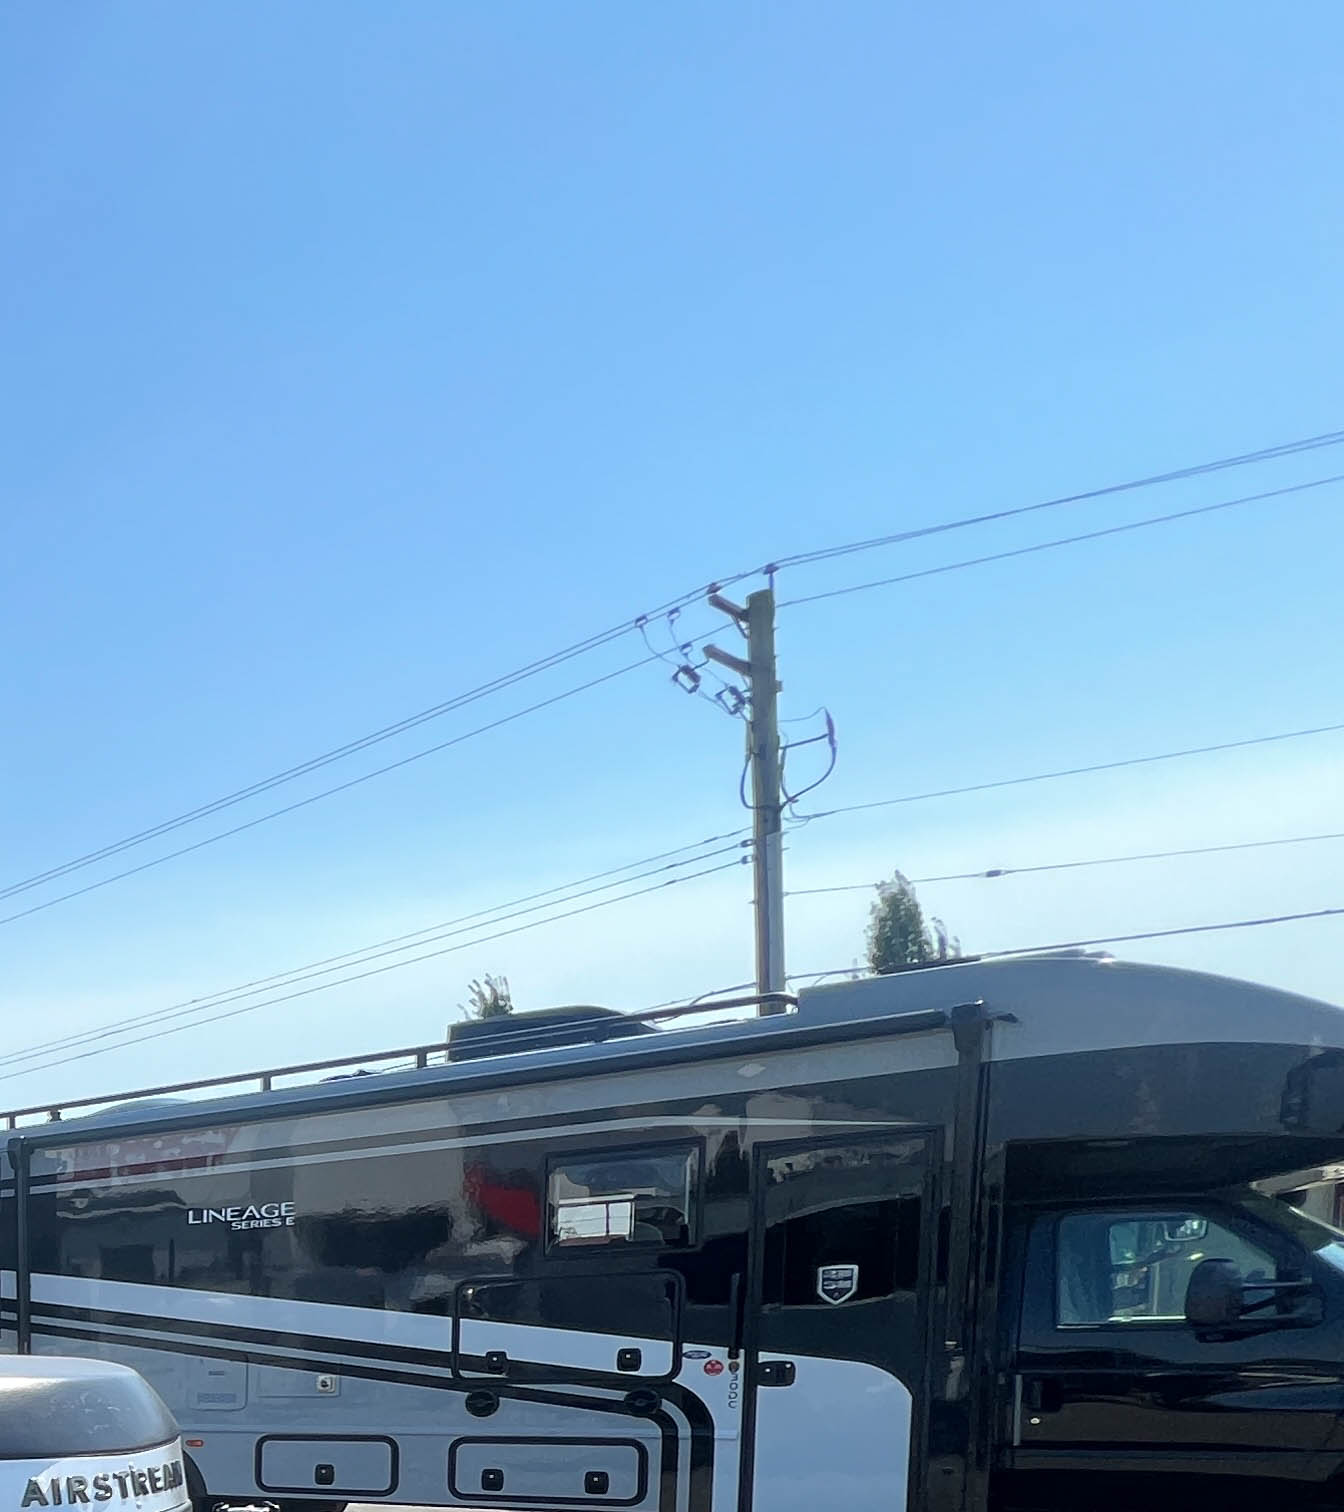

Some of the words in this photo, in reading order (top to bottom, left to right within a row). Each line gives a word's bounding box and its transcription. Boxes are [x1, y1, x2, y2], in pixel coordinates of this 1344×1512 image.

[188, 1201, 296, 1225] LINEAGE
[231, 1217, 282, 1231] SERIES
[285, 1216, 295, 1226] E
